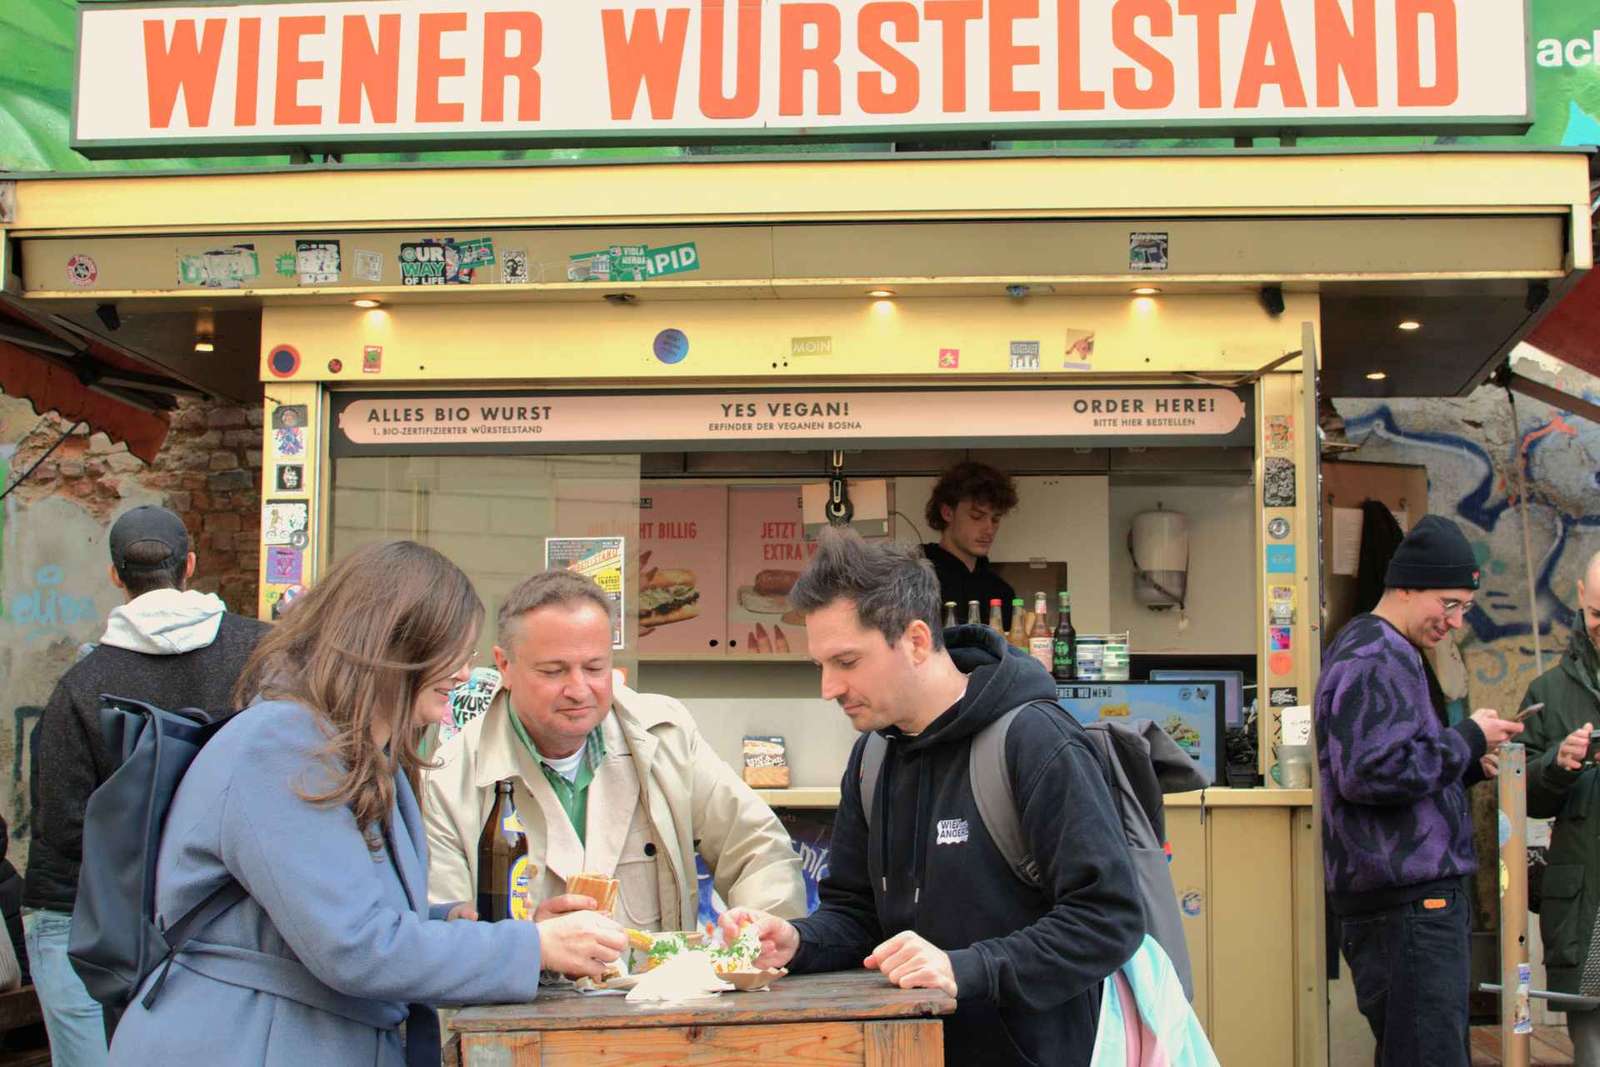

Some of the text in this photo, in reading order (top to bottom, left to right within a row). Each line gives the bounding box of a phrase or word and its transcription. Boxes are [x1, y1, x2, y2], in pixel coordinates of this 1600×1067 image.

[144, 12, 543, 128] WIENER
[401, 246, 444, 262] OUR
[401, 262, 445, 277] WAY
[404, 277, 445, 285] OF LIFE
[367, 405, 553, 423] ALLES BIO WURST
[720, 401, 849, 417] YES VEGAN!
[1073, 398, 1216, 414] ORDER HERE!
[373, 424, 543, 436] 1. BIO-ZERTIFIZIERTER WÜRSTELSTAND
[708, 421, 863, 432] ERFINDER DER VEGANEN BOSNA
[1093, 417, 1197, 427] BITTE HIER BESTELLEN
[658, 522, 697, 539] BILLIG
[760, 522, 797, 538] JETZT
[763, 543, 803, 560] EXTRA
